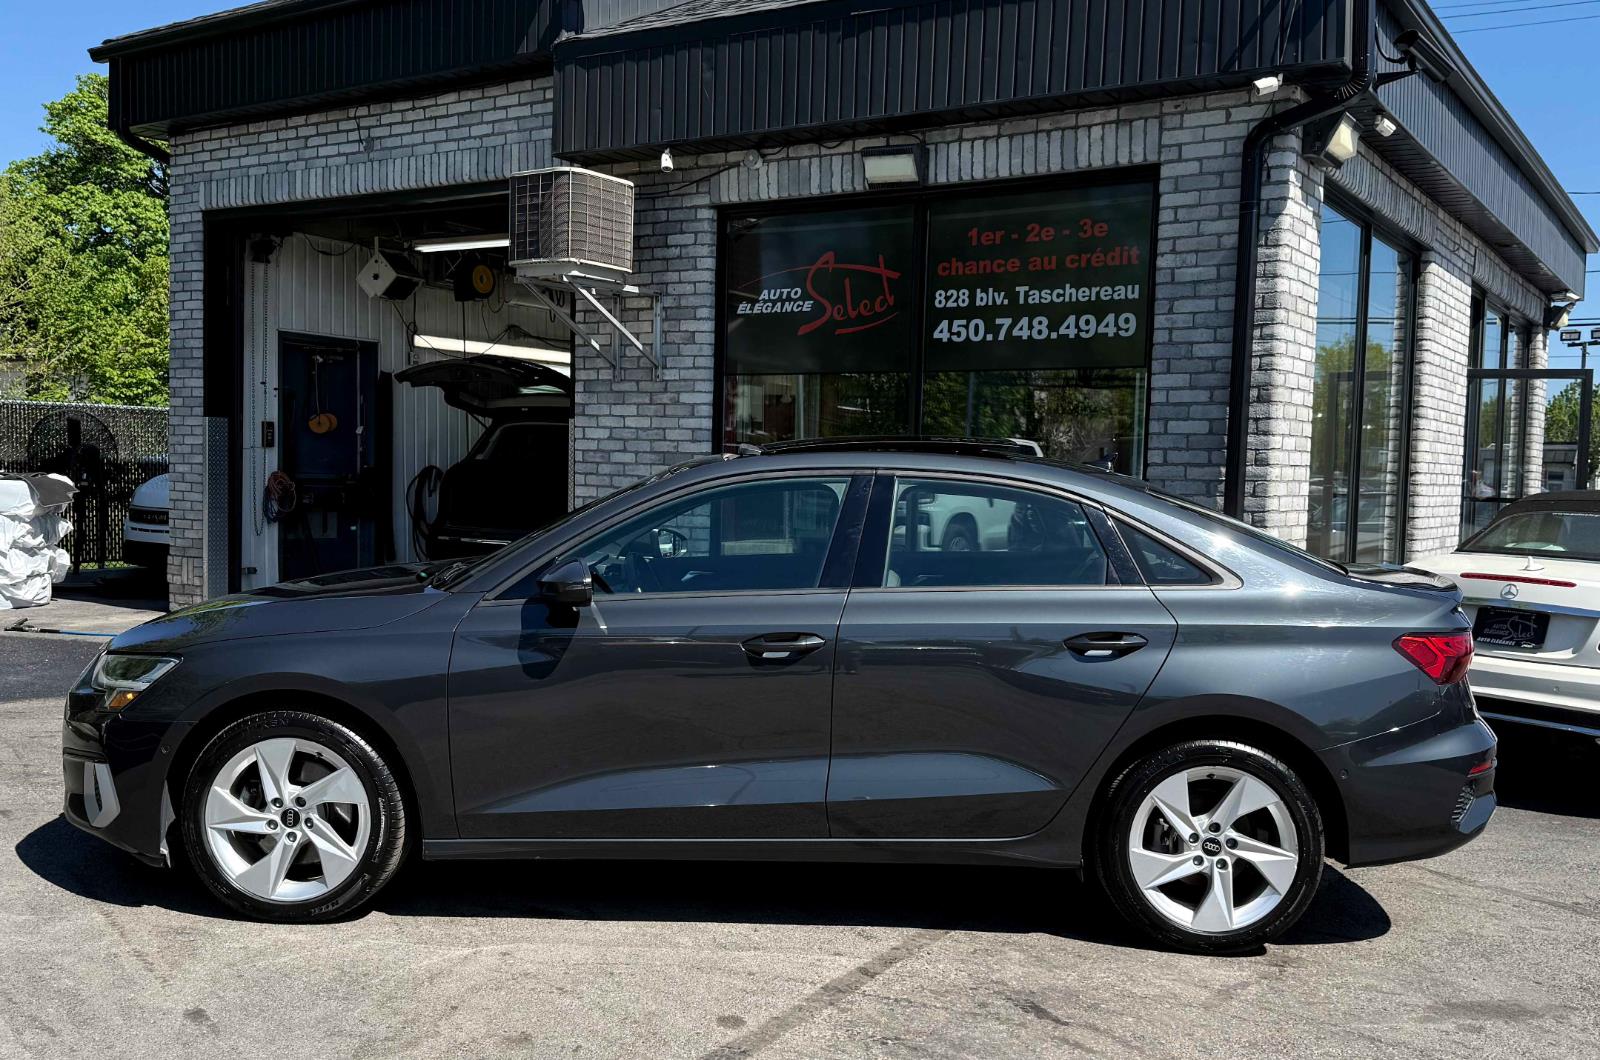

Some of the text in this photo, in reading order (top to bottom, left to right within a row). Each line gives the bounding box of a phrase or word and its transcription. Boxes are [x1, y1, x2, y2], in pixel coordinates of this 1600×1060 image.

[968, 227, 1005, 247] 1er
[1025, 223, 1055, 243] 2e
[1078, 218, 1109, 239] 3e
[937, 245, 1141, 277] chance au crédit
[758, 287, 802, 301] AUTO
[797, 250, 900, 335] Select
[934, 283, 1140, 309] 828 blv. Taschereau
[736, 300, 814, 315] ÉLÉGANCE
[933, 312, 1137, 343] 450.748.4949
